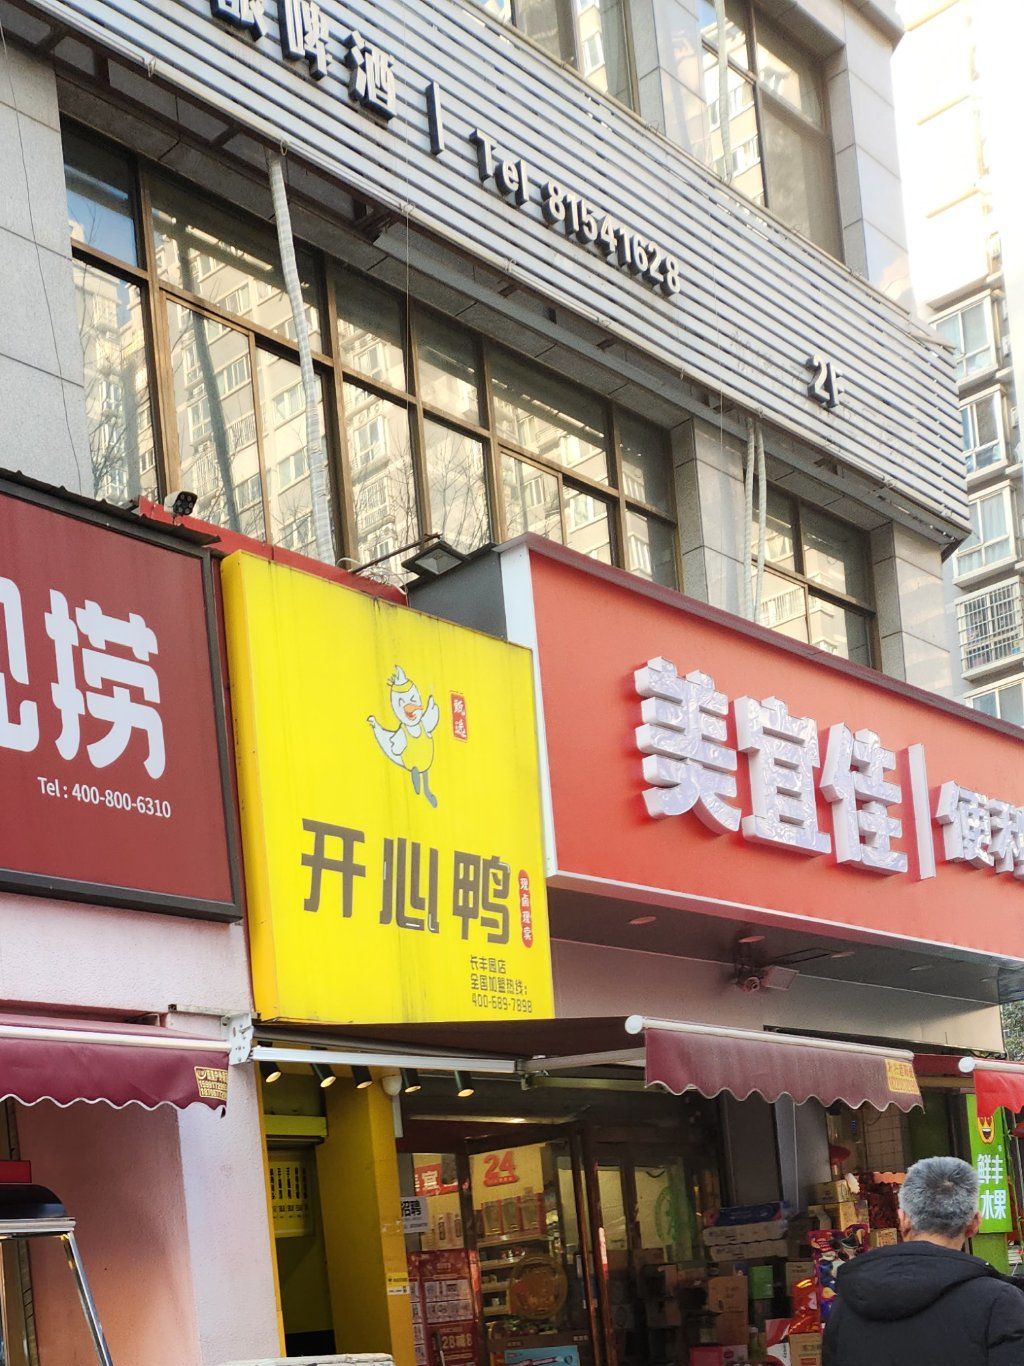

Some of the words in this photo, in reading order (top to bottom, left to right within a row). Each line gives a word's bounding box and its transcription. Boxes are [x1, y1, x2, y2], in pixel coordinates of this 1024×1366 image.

[469, 128, 529, 206] Tel
[540, 180, 680, 298] 81541628
[805, 354, 844, 409] 2F
[633, 656, 908, 877] 美宜佳
[72, 783, 171, 818] 400-800-6310
[301, 818, 511, 946] 开心鸭
[471, 992, 533, 1013] 400-689-7898
[483, 1150, 516, 1177] 24
